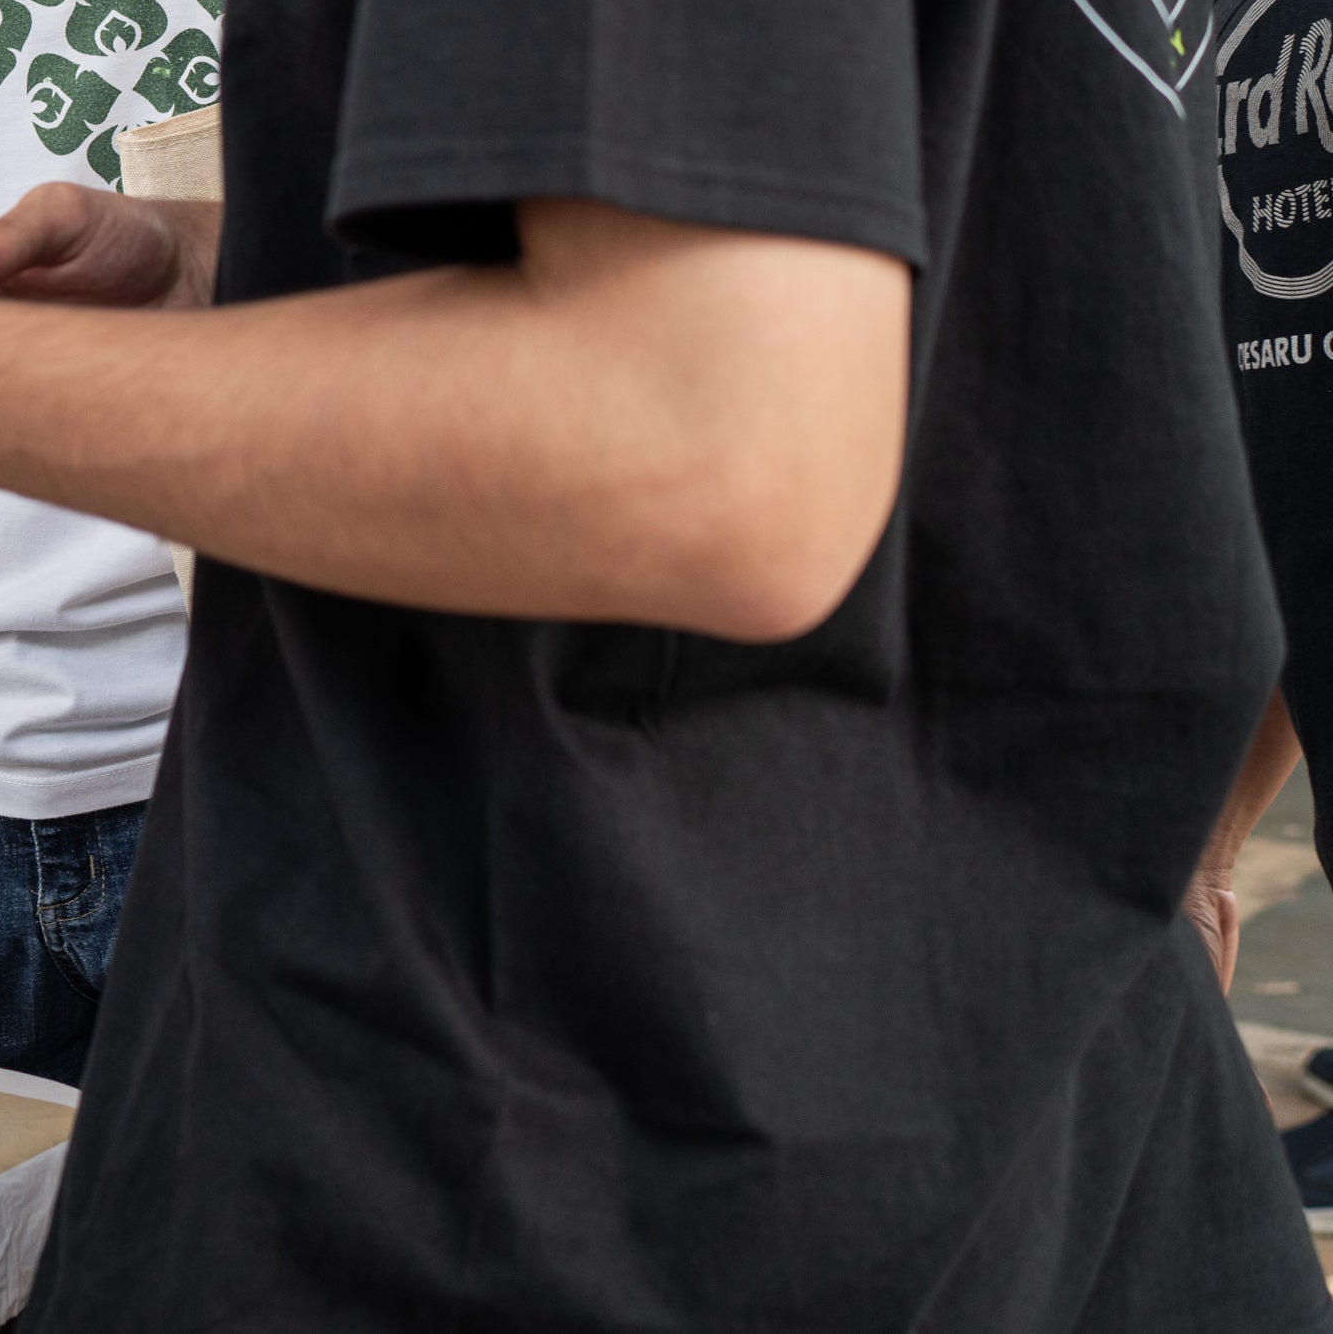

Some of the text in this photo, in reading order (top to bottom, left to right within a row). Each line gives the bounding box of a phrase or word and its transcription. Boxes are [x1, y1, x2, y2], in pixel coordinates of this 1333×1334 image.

[1217, 17, 1333, 156] rd R
[1253, 177, 1333, 233] HOTE
